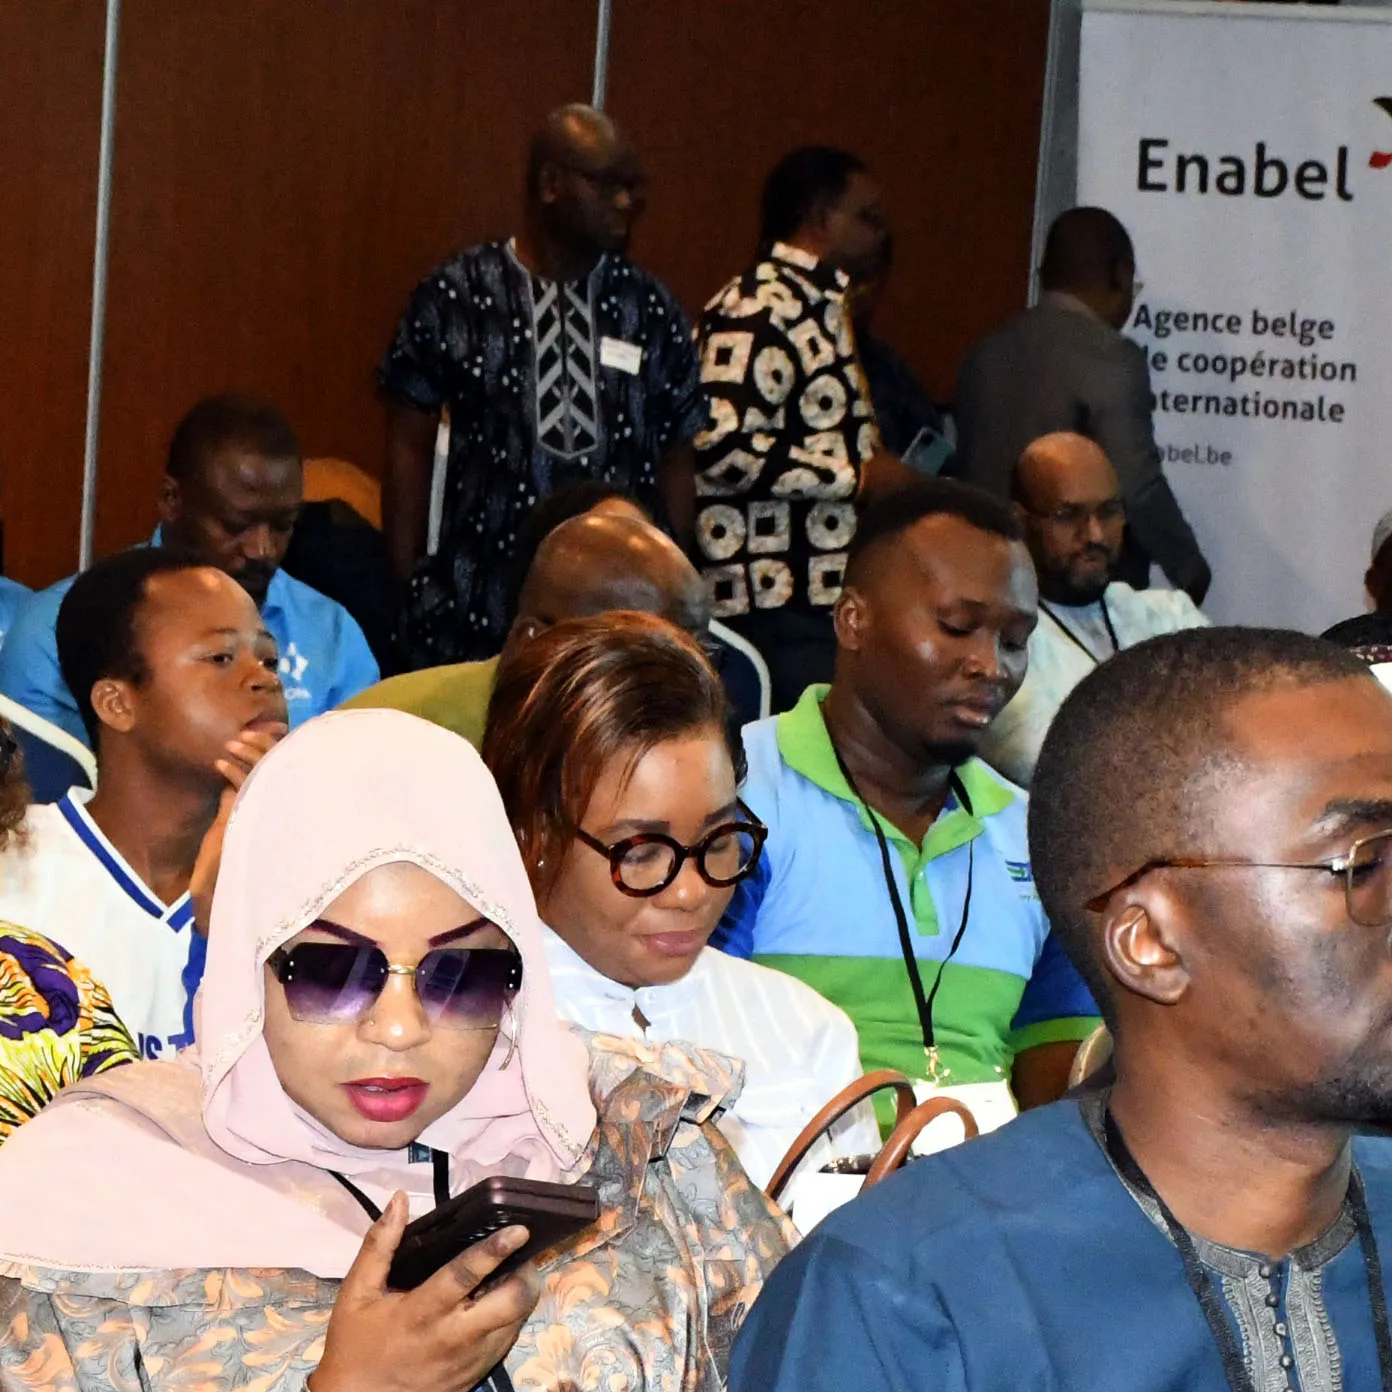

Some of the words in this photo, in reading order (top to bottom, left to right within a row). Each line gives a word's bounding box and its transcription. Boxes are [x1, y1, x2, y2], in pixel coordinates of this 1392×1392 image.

[1137, 138, 1354, 201] Enabel
[1133, 304, 1242, 339] Agence
[1252, 309, 1335, 346] belge
[1144, 344, 1168, 372] e
[1177, 350, 1357, 382] coopération
[1149, 390, 1345, 423] ternationale
